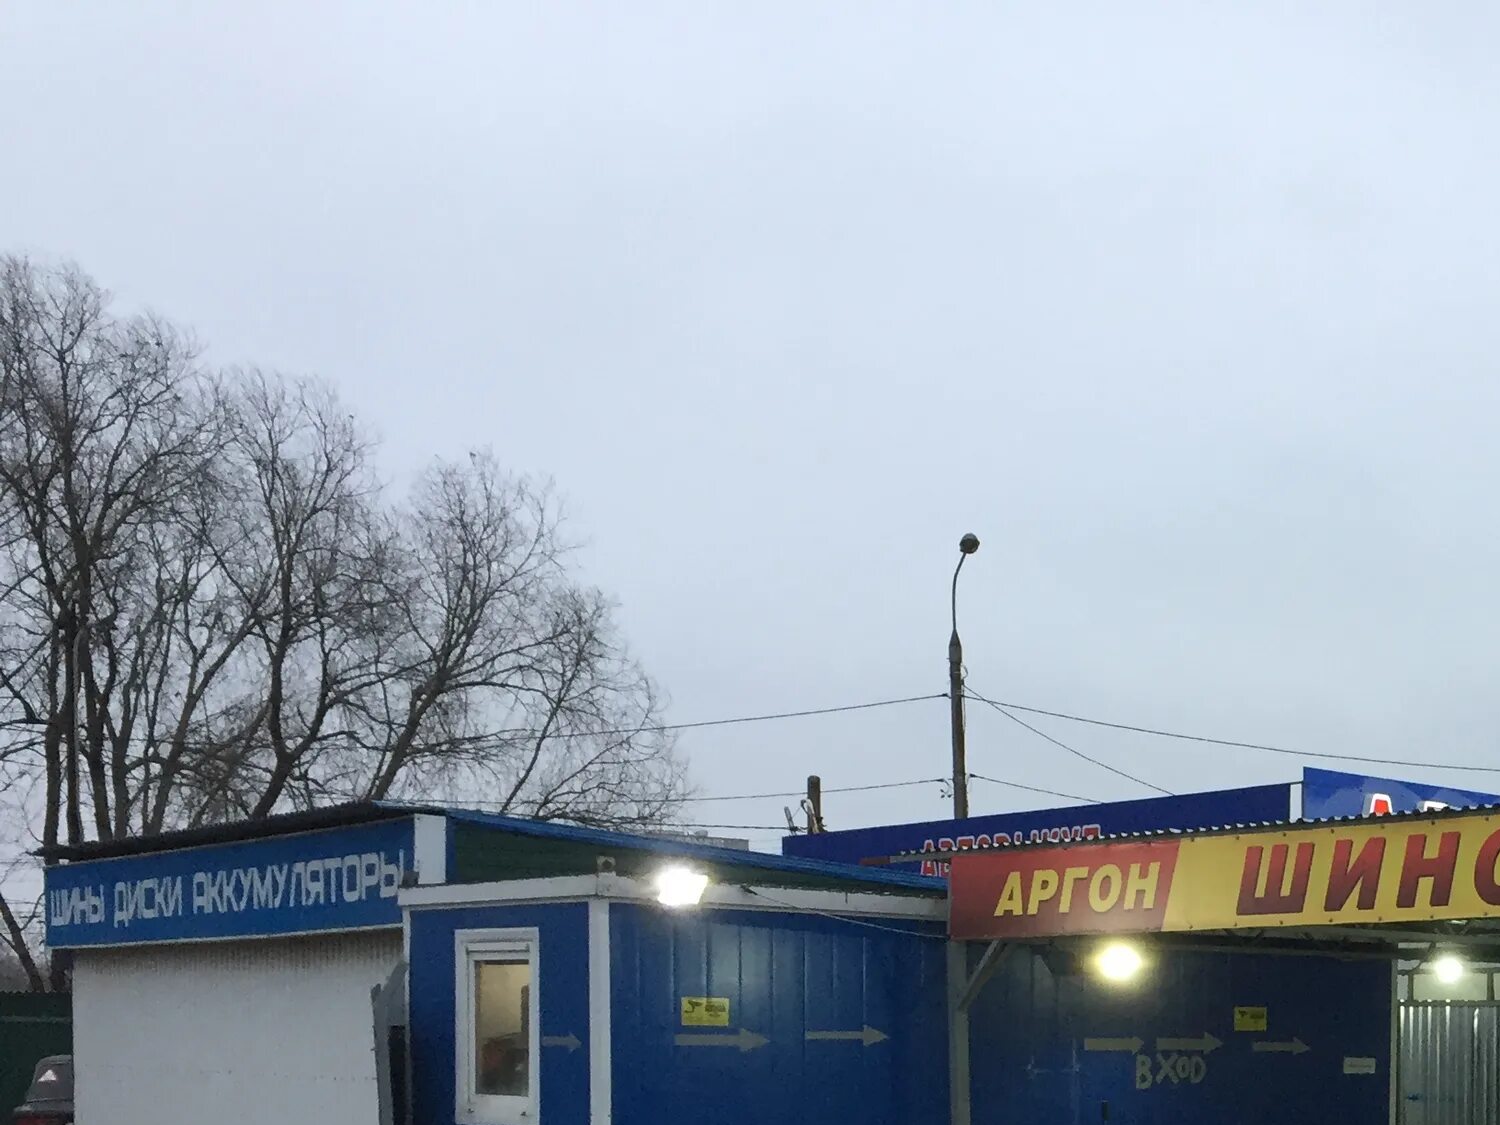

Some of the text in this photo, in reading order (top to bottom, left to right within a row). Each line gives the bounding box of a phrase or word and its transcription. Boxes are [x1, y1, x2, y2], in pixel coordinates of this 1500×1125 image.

[50, 849, 405, 929] ШИНЫ ДИСКИ АККУМУЛЯТОРЫ
[993, 861, 1161, 917] АРГОН
